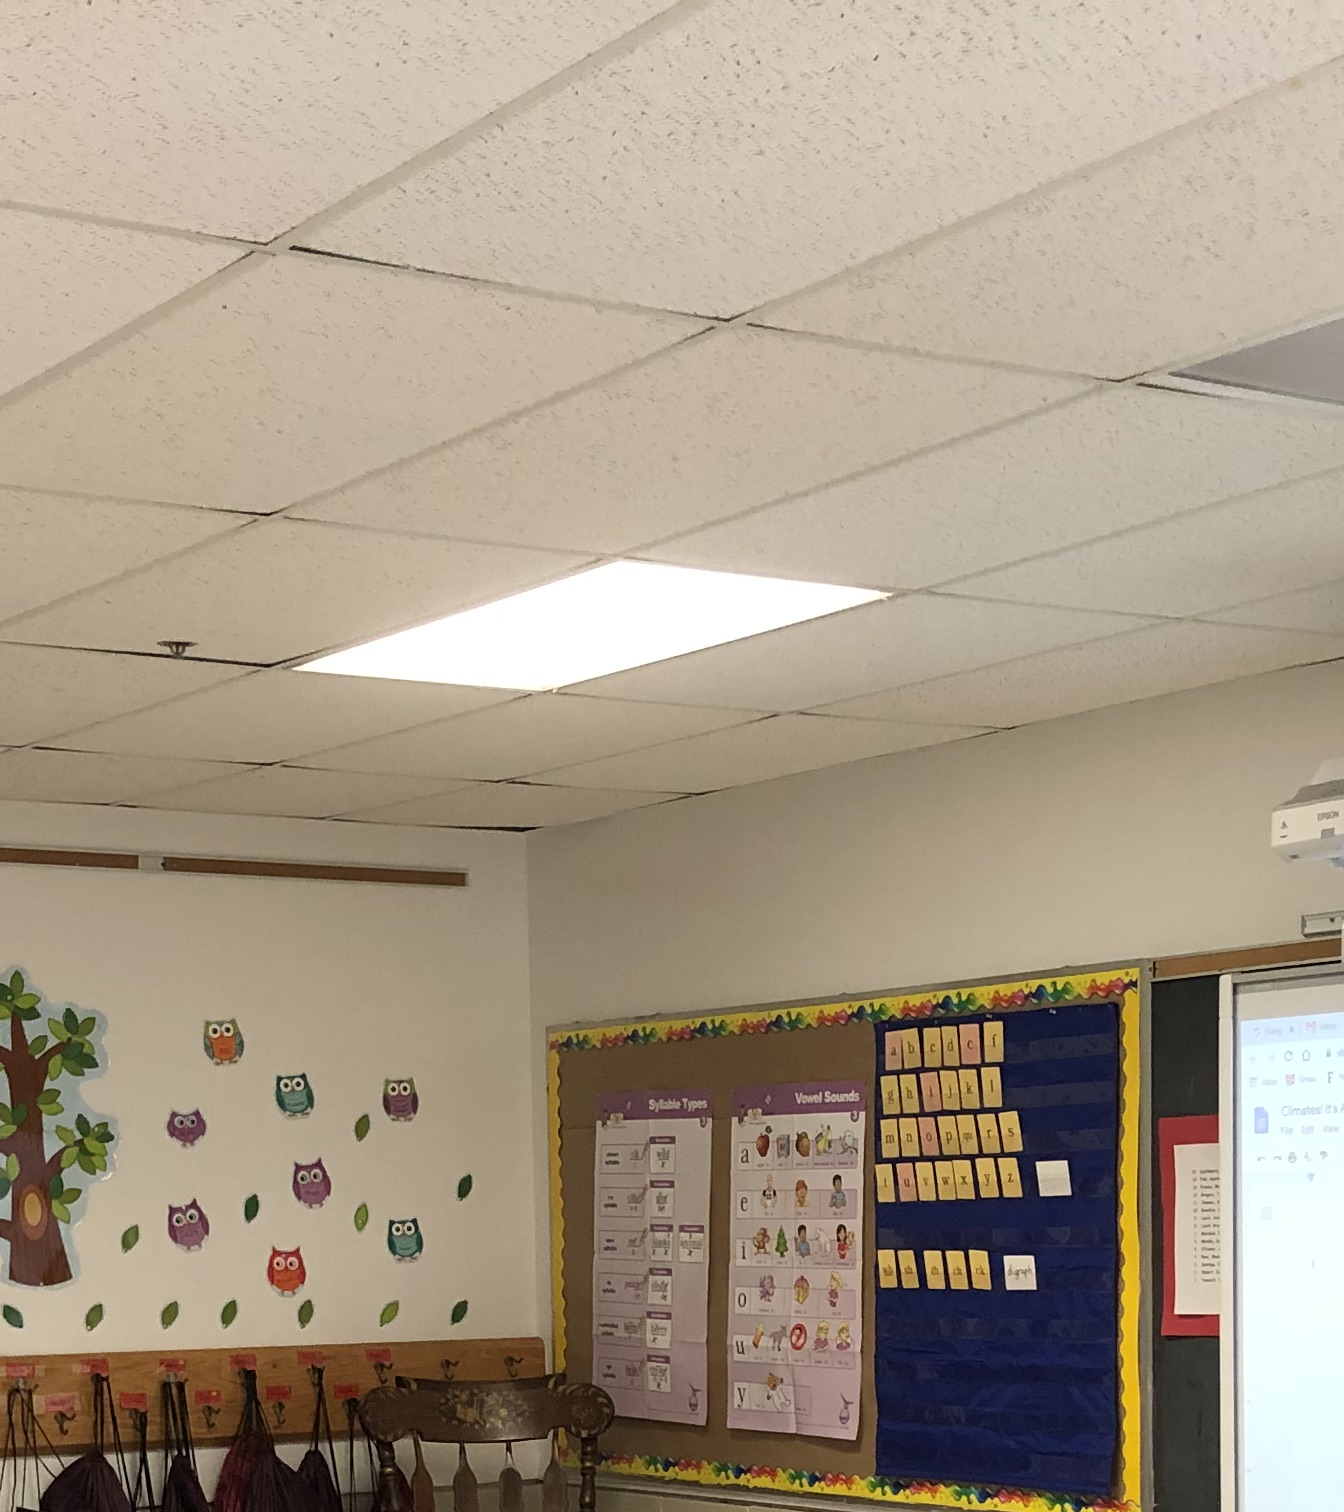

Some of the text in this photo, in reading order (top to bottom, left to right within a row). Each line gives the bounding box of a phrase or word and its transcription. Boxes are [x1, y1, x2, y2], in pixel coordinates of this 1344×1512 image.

[1317, 810, 1340, 822] EPSON
[890, 1034, 998, 1056] a b c d f
[794, 1089, 860, 1105] Vowel Sounds
[887, 1090, 894, 1104] g
[906, 1086, 913, 1100] h
[947, 1085, 953, 1098] j
[966, 1081, 974, 1095] k
[648, 1097, 708, 1113] Syllable Types
[885, 1133, 895, 1144] m
[905, 1132, 913, 1143] n
[925, 1132, 932, 1143] o
[945, 1130, 953, 1144] p
[986, 1128, 992, 1139] r
[1008, 1127, 1015, 1138] s
[1281, 1126, 1293, 1136] File
[1301, 1125, 1315, 1135] Edit
[1322, 1124, 1340, 1134] View
[740, 1148, 750, 1164] a
[903, 1177, 911, 1188] u
[922, 1176, 929, 1187] v
[941, 1175, 951, 1186] w
[960, 1174, 968, 1185] x
[984, 1172, 991, 1186] y
[1007, 1172, 1015, 1183] z
[740, 1195, 748, 1212] e
[741, 1241, 746, 1260] i
[737, 1292, 747, 1308] o
[735, 1340, 745, 1354] u
[737, 1387, 746, 1408] y
